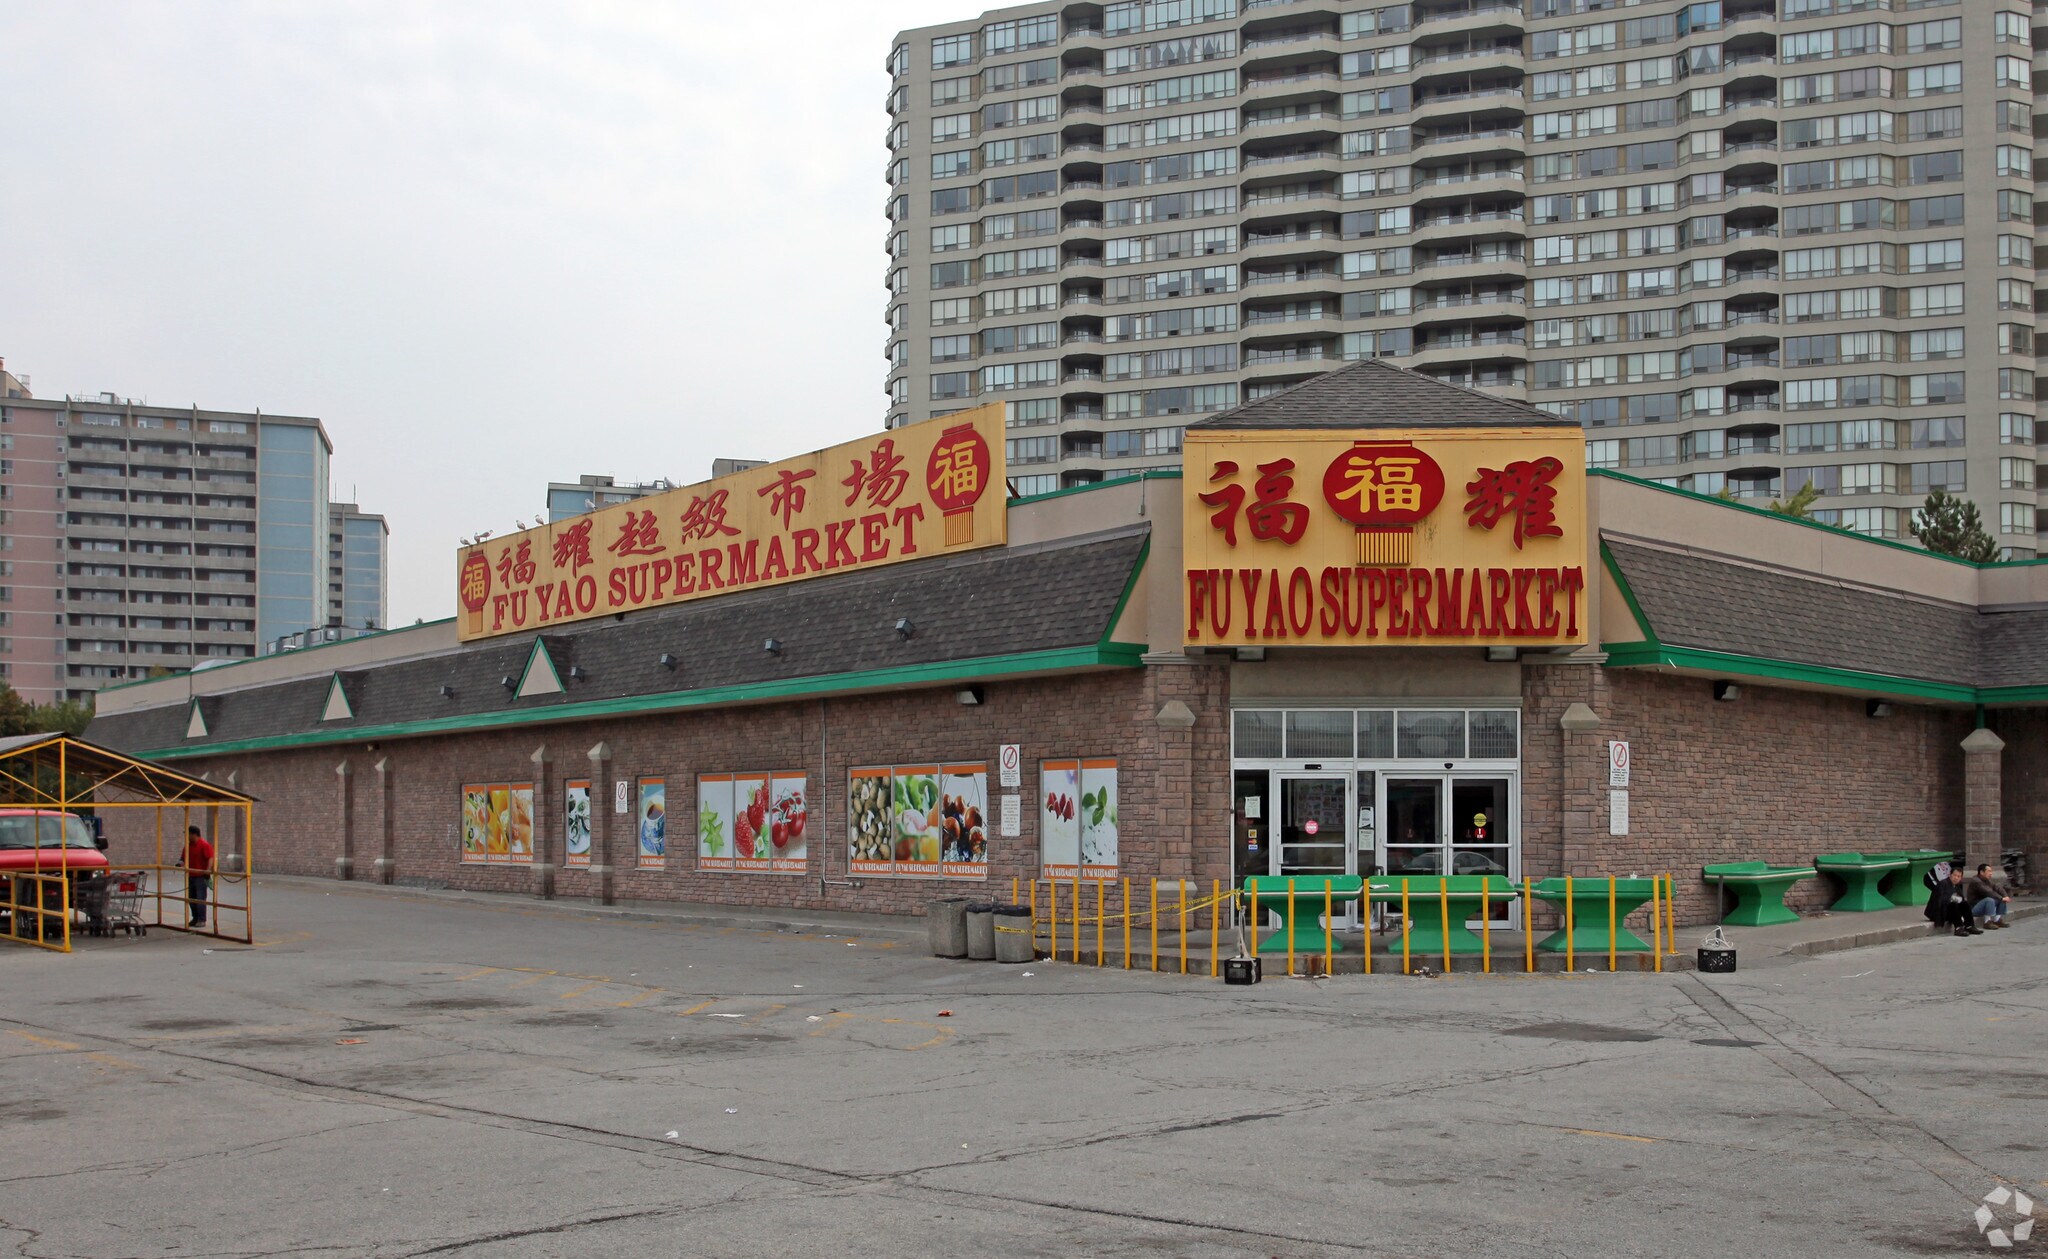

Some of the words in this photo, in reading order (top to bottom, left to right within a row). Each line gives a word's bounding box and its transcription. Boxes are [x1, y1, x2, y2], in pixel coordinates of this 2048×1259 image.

[930, 440, 978, 499] 福
[1198, 457, 1310, 547] 福
[1335, 456, 1422, 513] 福
[1463, 456, 1564, 551] 耀
[496, 438, 910, 590] 福耀超級市場
[463, 562, 485, 602] 福
[492, 589, 528, 631] FU
[535, 574, 597, 621] YAO
[608, 502, 925, 607] SUPERMARKET
[1187, 568, 1233, 638] FU
[1239, 566, 1314, 638] YAO
[1319, 566, 1584, 638] SUPERMARKET
